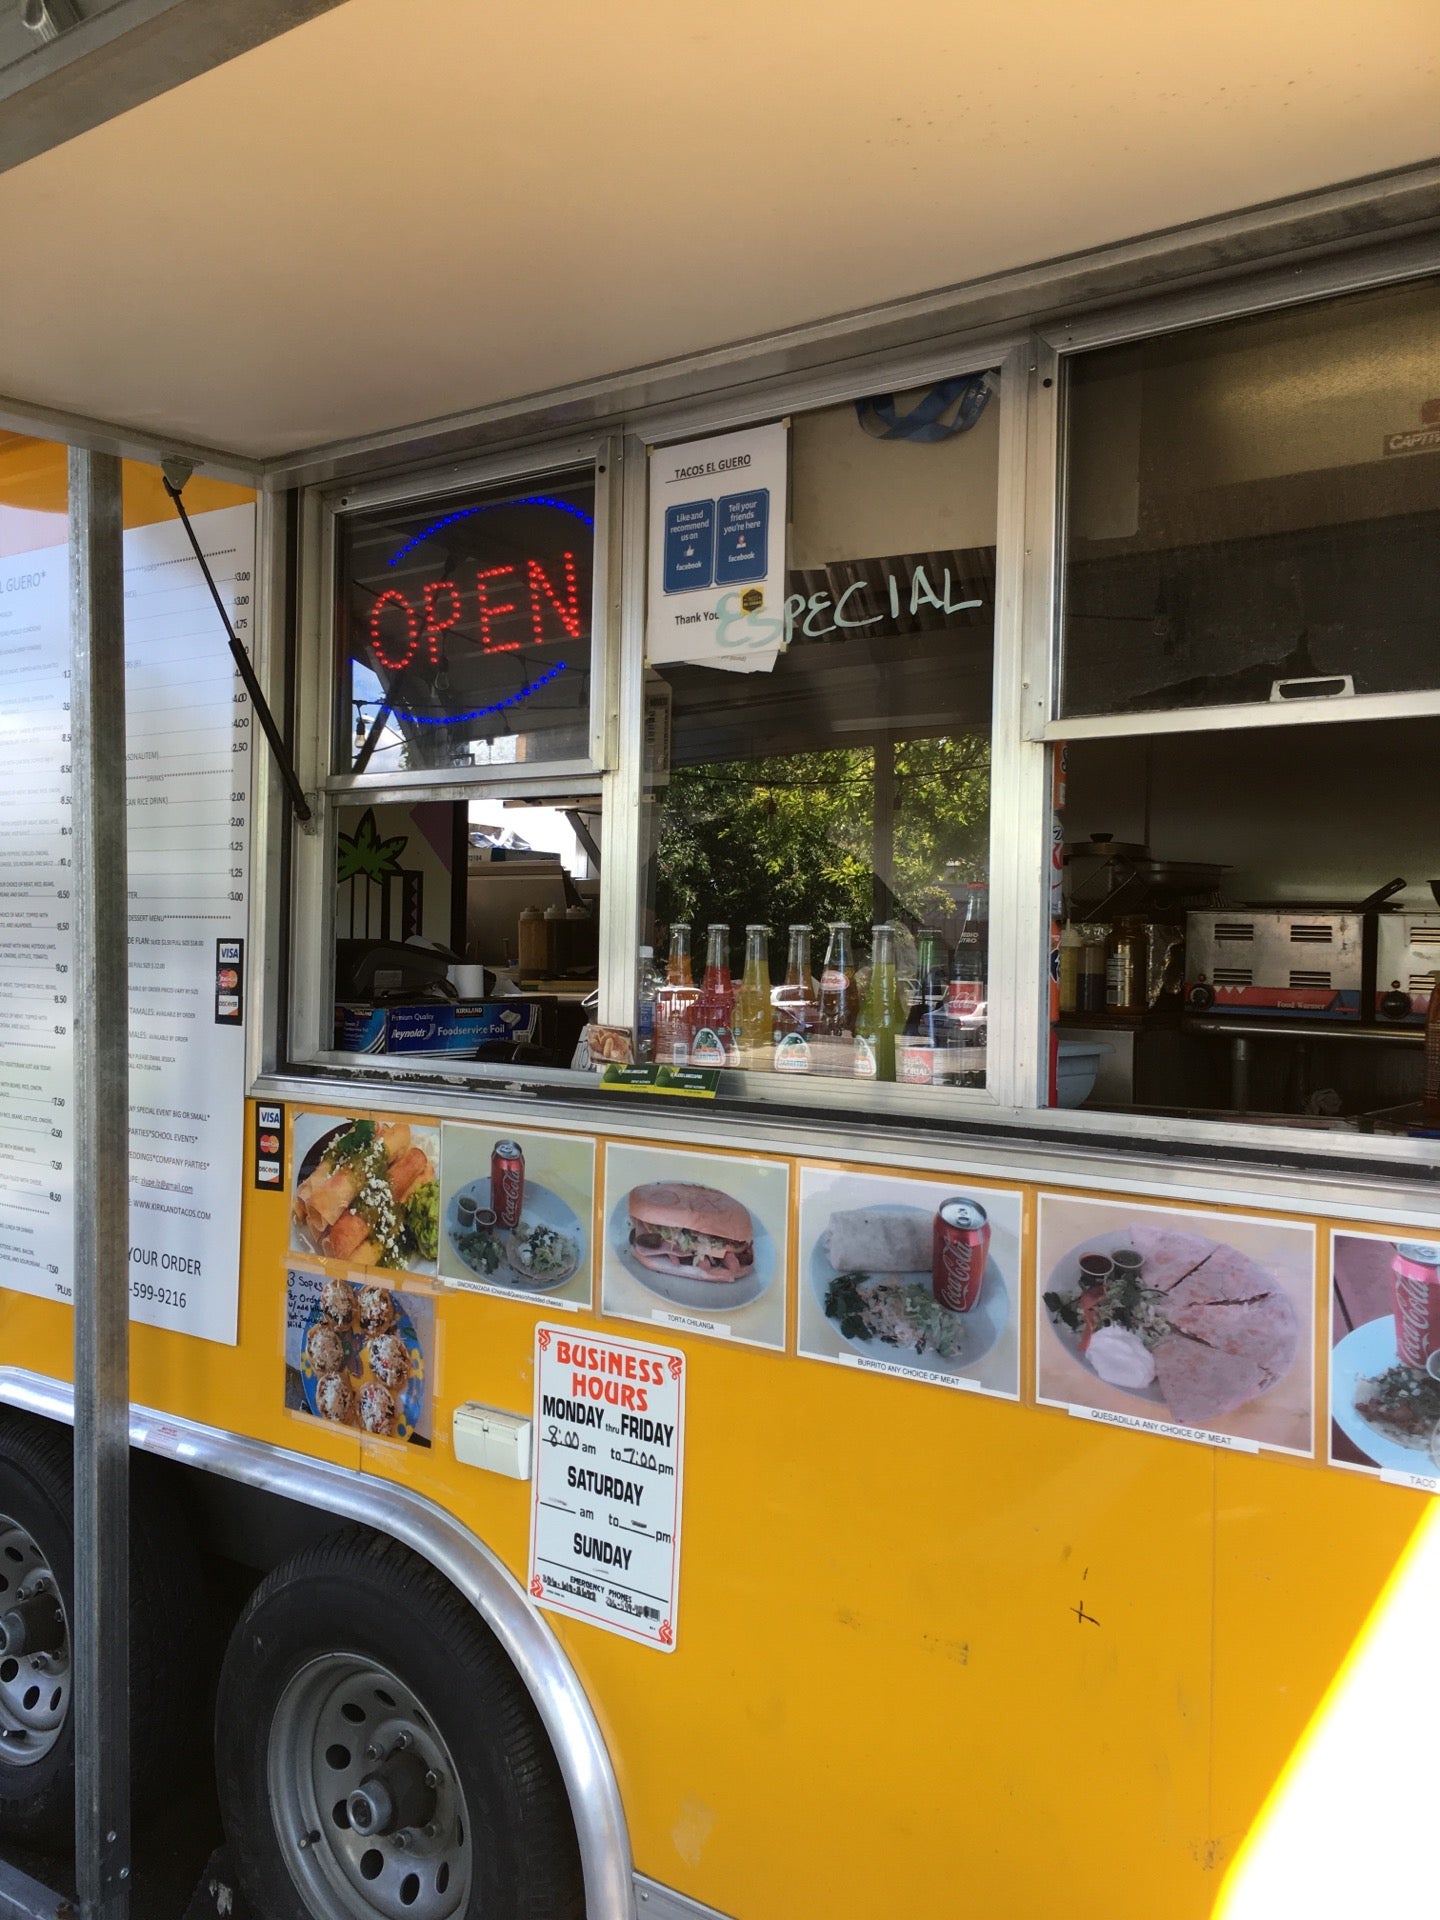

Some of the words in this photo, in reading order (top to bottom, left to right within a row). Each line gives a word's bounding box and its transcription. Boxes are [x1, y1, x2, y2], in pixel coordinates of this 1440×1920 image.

[675, 464, 704, 479] TACOS
[707, 463, 716, 472] EL
[718, 454, 751, 470] GUERO
[728, 504, 740, 512] Tell
[740, 501, 757, 513] your
[676, 513, 690, 523] Like
[690, 510, 704, 519] and
[730, 511, 754, 522] friends
[670, 519, 709, 533] recommend
[745, 520, 761, 529] here
[728, 552, 755, 562] facebook
[675, 560, 702, 571] facebook
[370, 552, 581, 670] OPEN
[715, 565, 983, 648] ESPECIAL
[675, 612, 701, 626] Thank
[233, 718, 249, 728] 4.00
[232, 742, 248, 752] 2.50
[231, 792, 245, 802] 2.00
[231, 817, 244, 827] 2.00
[231, 842, 243, 851] 1.25
[231, 868, 243, 877] 1.25
[230, 891, 243, 901] 3.00
[221, 948, 239, 958] VISA
[54, 995, 67, 1003] 8.50
[54, 1025, 66, 1035] 8.50
[437, 1026, 488, 1036] Foodservice
[489, 1024, 505, 1034] Foil
[136, 1106, 155, 1115] SPECIAL
[156, 1108, 171, 1116] EVENT
[172, 1110, 181, 1118] BIG
[261, 1111, 280, 1124] VISA
[49, 1191, 61, 1202] 8.50
[128, 1247, 158, 1267] YOUR
[161, 1253, 202, 1276] ORDER
[287, 1271, 296, 1287] 3
[298, 1276, 323, 1292] Sopes
[667, 1314, 687, 1324] TORTA
[687, 1317, 715, 1331] CHILANGA
[857, 1358, 887, 1371] BURRITO
[888, 1365, 902, 1374] ANY
[902, 1367, 929, 1379] CHOICE
[929, 1373, 939, 1381] OF
[940, 1375, 960, 1385] MEAT
[572, 1373, 648, 1412] HOURS
[543, 1395, 604, 1430] MONDAY
[605, 1422, 620, 1435] thru
[620, 1414, 674, 1448] FRIDAY
[1091, 1409, 1140, 1428] QUESADILLA
[1141, 1419, 1160, 1431] ANY
[1160, 1422, 1192, 1438] CHOICE
[1193, 1430, 1206, 1440] OF
[1208, 1434, 1232, 1446] MEAT
[548, 1425, 579, 1449] 8:00
[582, 1442, 596, 1455] am
[610, 1447, 621, 1461] to
[623, 1447, 657, 1471] 7:00
[657, 1462, 674, 1476] pm
[567, 1465, 643, 1507] SATURDAY
[1410, 1475, 1437, 1489] TACO
[579, 1508, 594, 1520] am
[608, 1513, 620, 1528] to
[655, 1529, 671, 1544] pm
[573, 1532, 632, 1571] SUNDAY
[570, 1575, 605, 1593] EMERGENCY
[608, 1589, 632, 1603] PHONES
